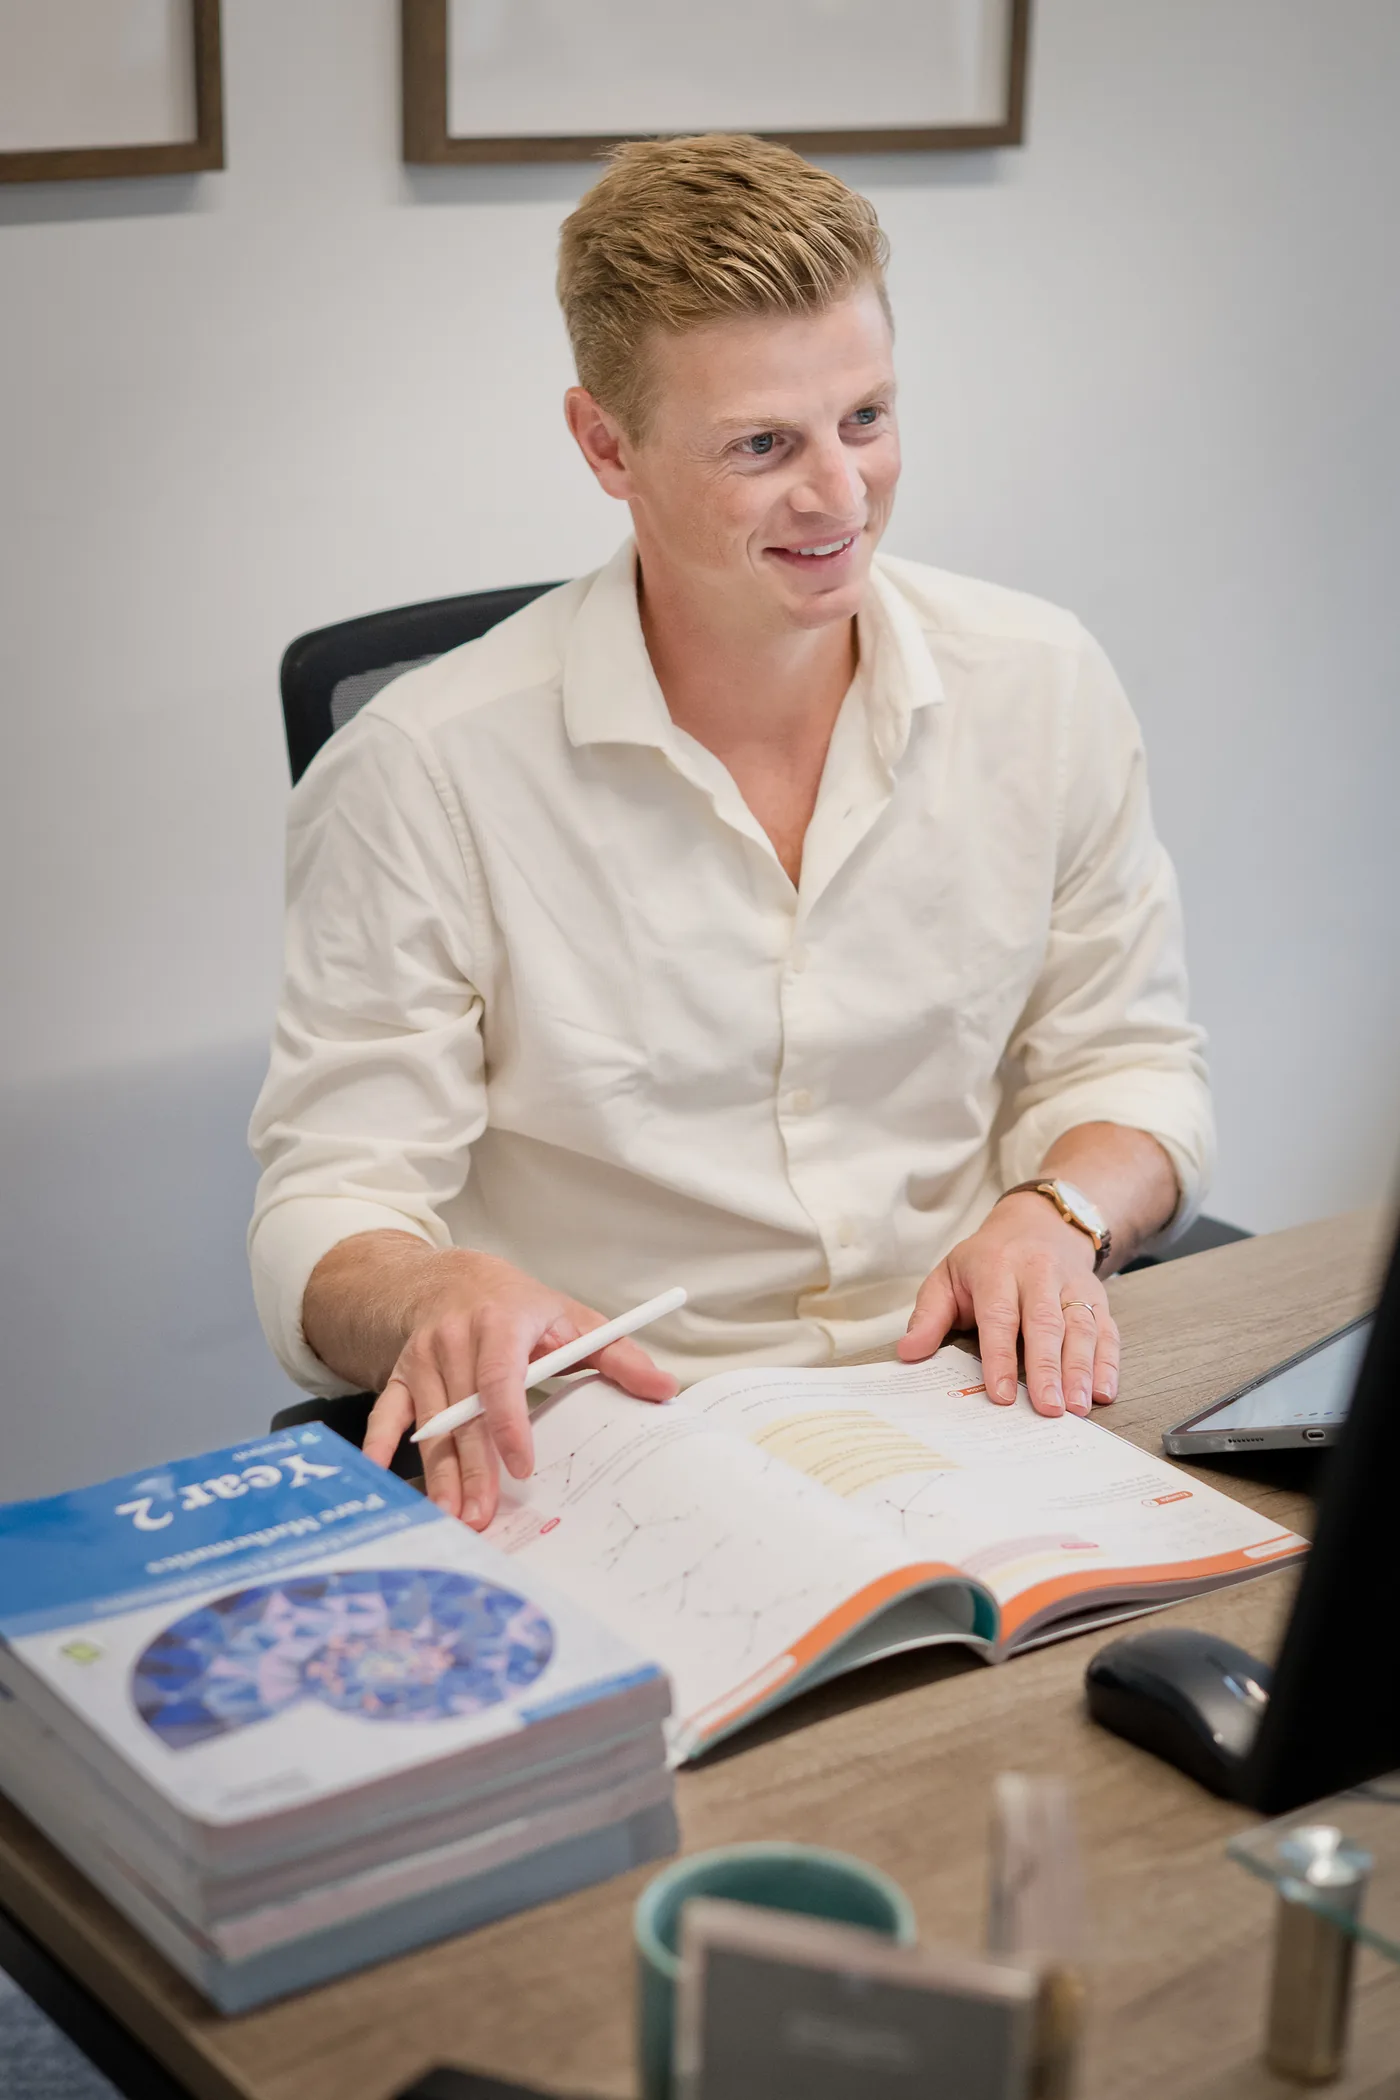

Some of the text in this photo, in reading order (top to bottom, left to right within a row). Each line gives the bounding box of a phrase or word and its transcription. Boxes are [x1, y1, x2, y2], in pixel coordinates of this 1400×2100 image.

[115, 1453, 343, 1531] Year 2
[319, 1494, 387, 1524] Pure
[146, 1515, 321, 1574] Mathematics
